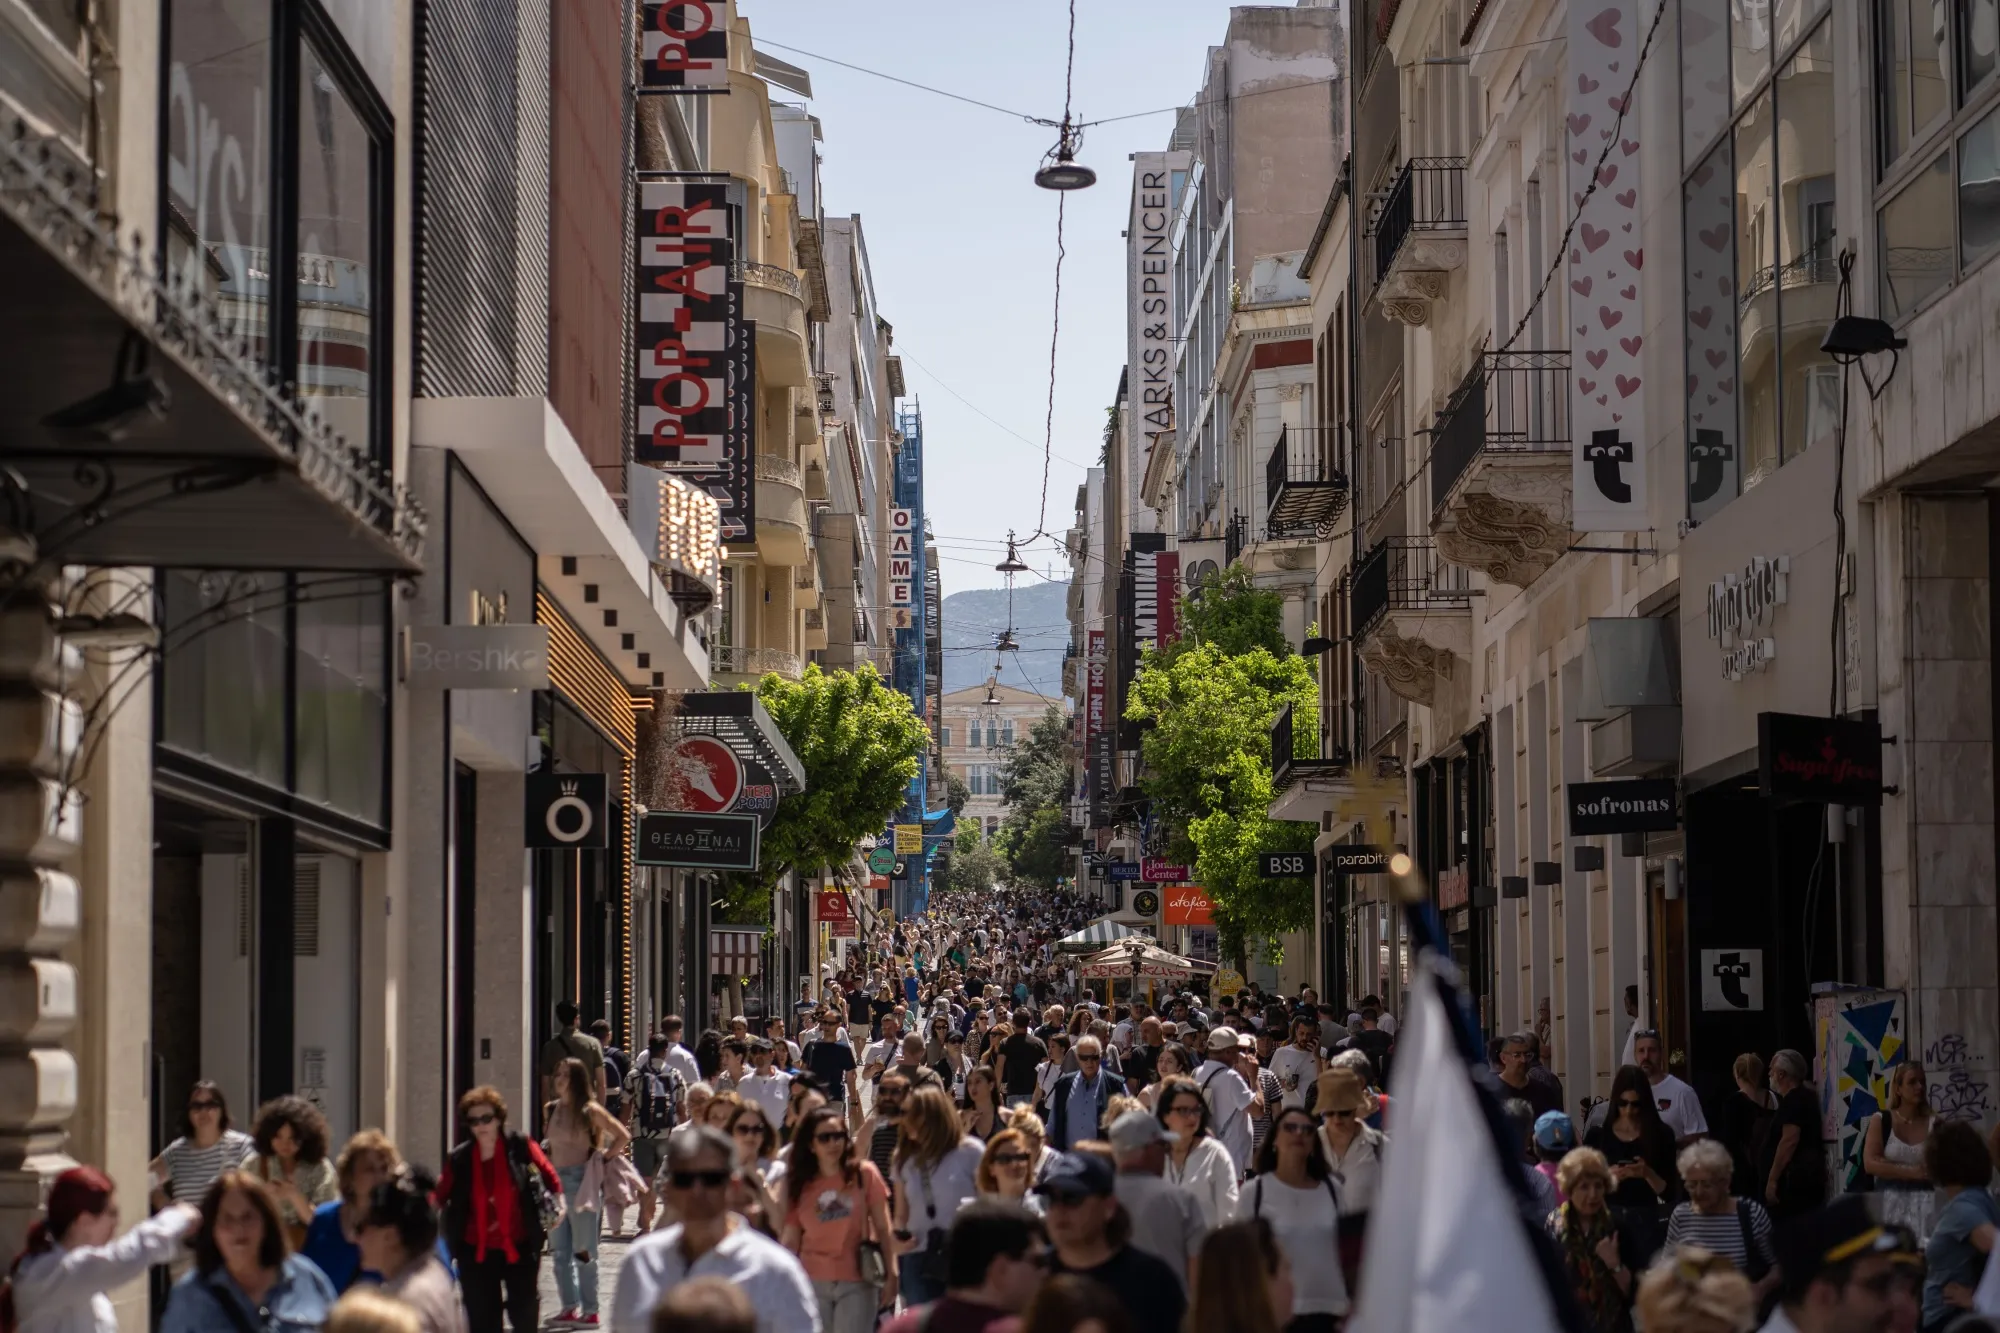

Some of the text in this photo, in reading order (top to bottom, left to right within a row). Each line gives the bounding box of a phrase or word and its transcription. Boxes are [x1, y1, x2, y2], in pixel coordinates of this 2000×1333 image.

[1142, 171, 1167, 314] SPENCER
[653, 199, 712, 446] POP-AIR
[1143, 322, 1167, 340] &
[1134, 551, 1157, 681] AMDUNK
[412, 642, 540, 672] Bershka
[1100, 736, 1109, 814] FUKYBUDDHA
[1576, 796, 1670, 816] sofronas
[1145, 869, 1180, 879] Center
[1269, 857, 1305, 873] BSB
